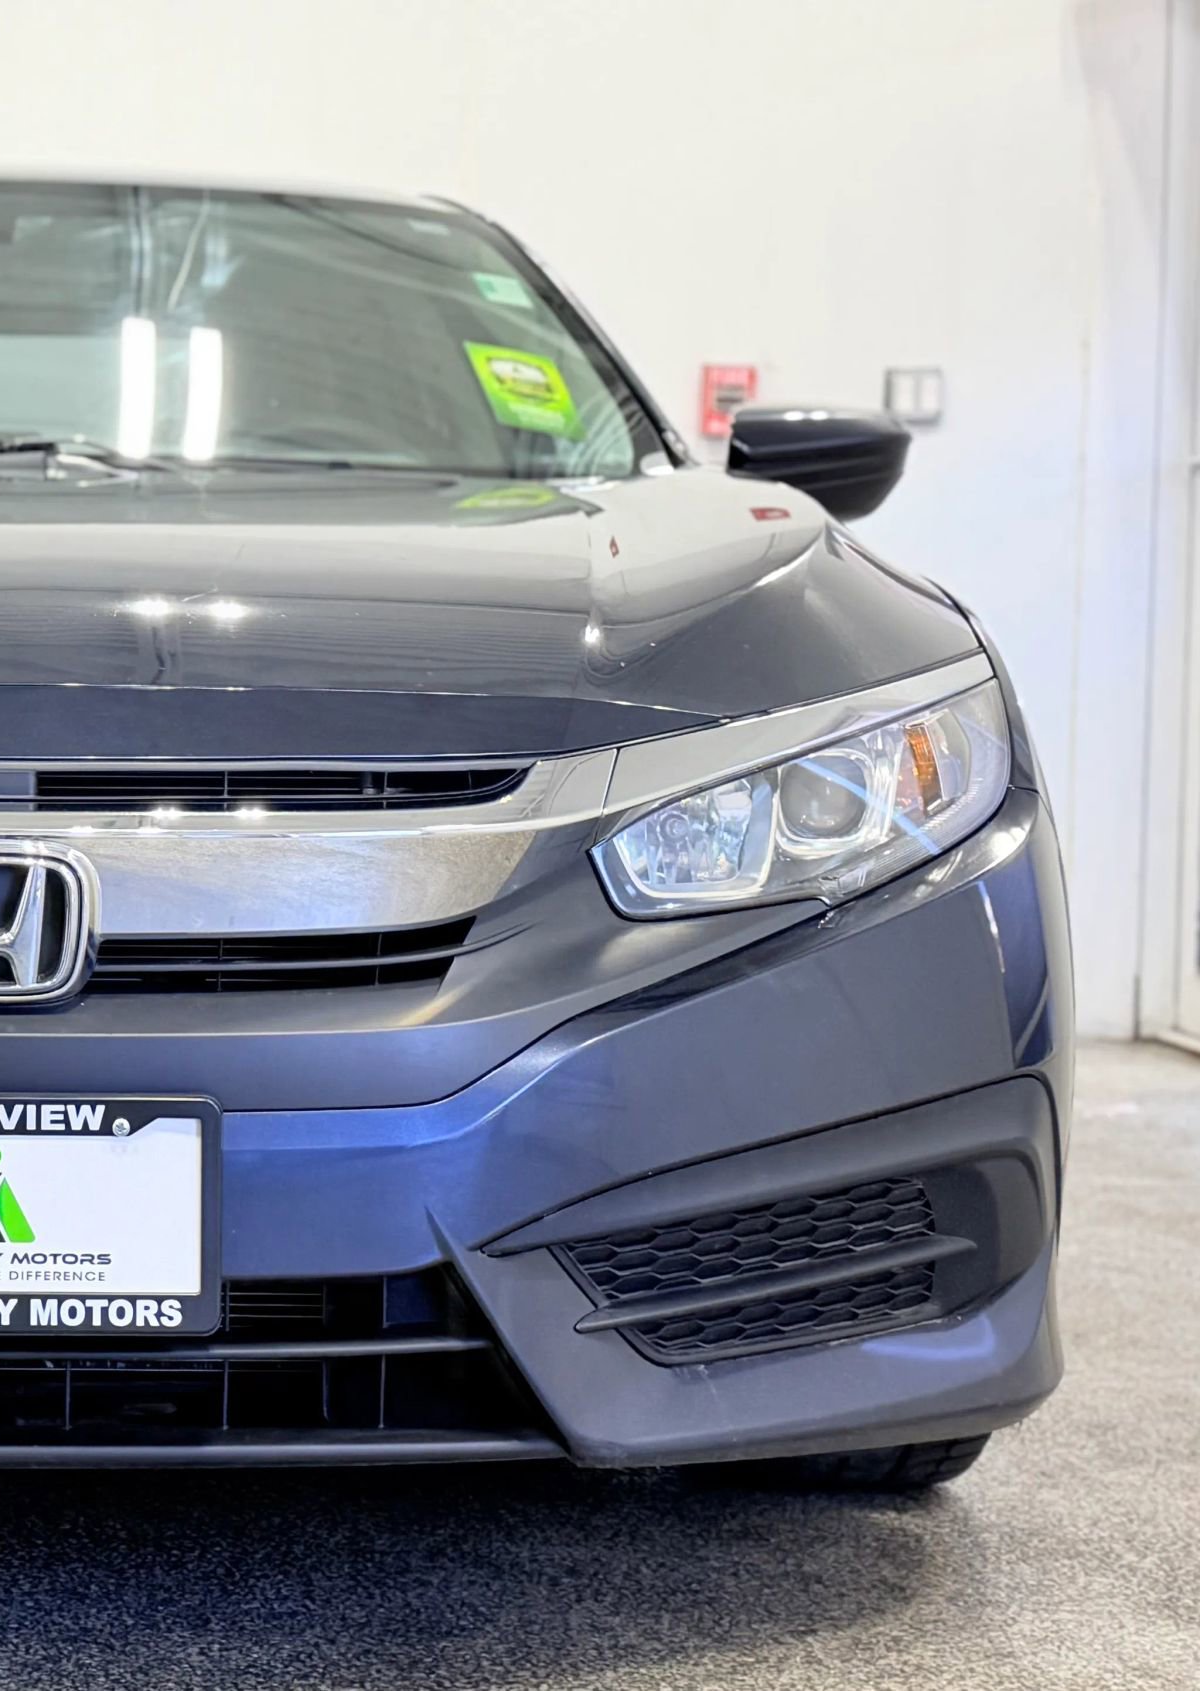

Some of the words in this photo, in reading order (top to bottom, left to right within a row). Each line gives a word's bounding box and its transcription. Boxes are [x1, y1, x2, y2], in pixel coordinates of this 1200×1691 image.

[10, 1252, 112, 1265] MOTORS
[9, 1270, 106, 1282] DIFFERENCE
[29, 1298, 183, 1328] MOTORS
